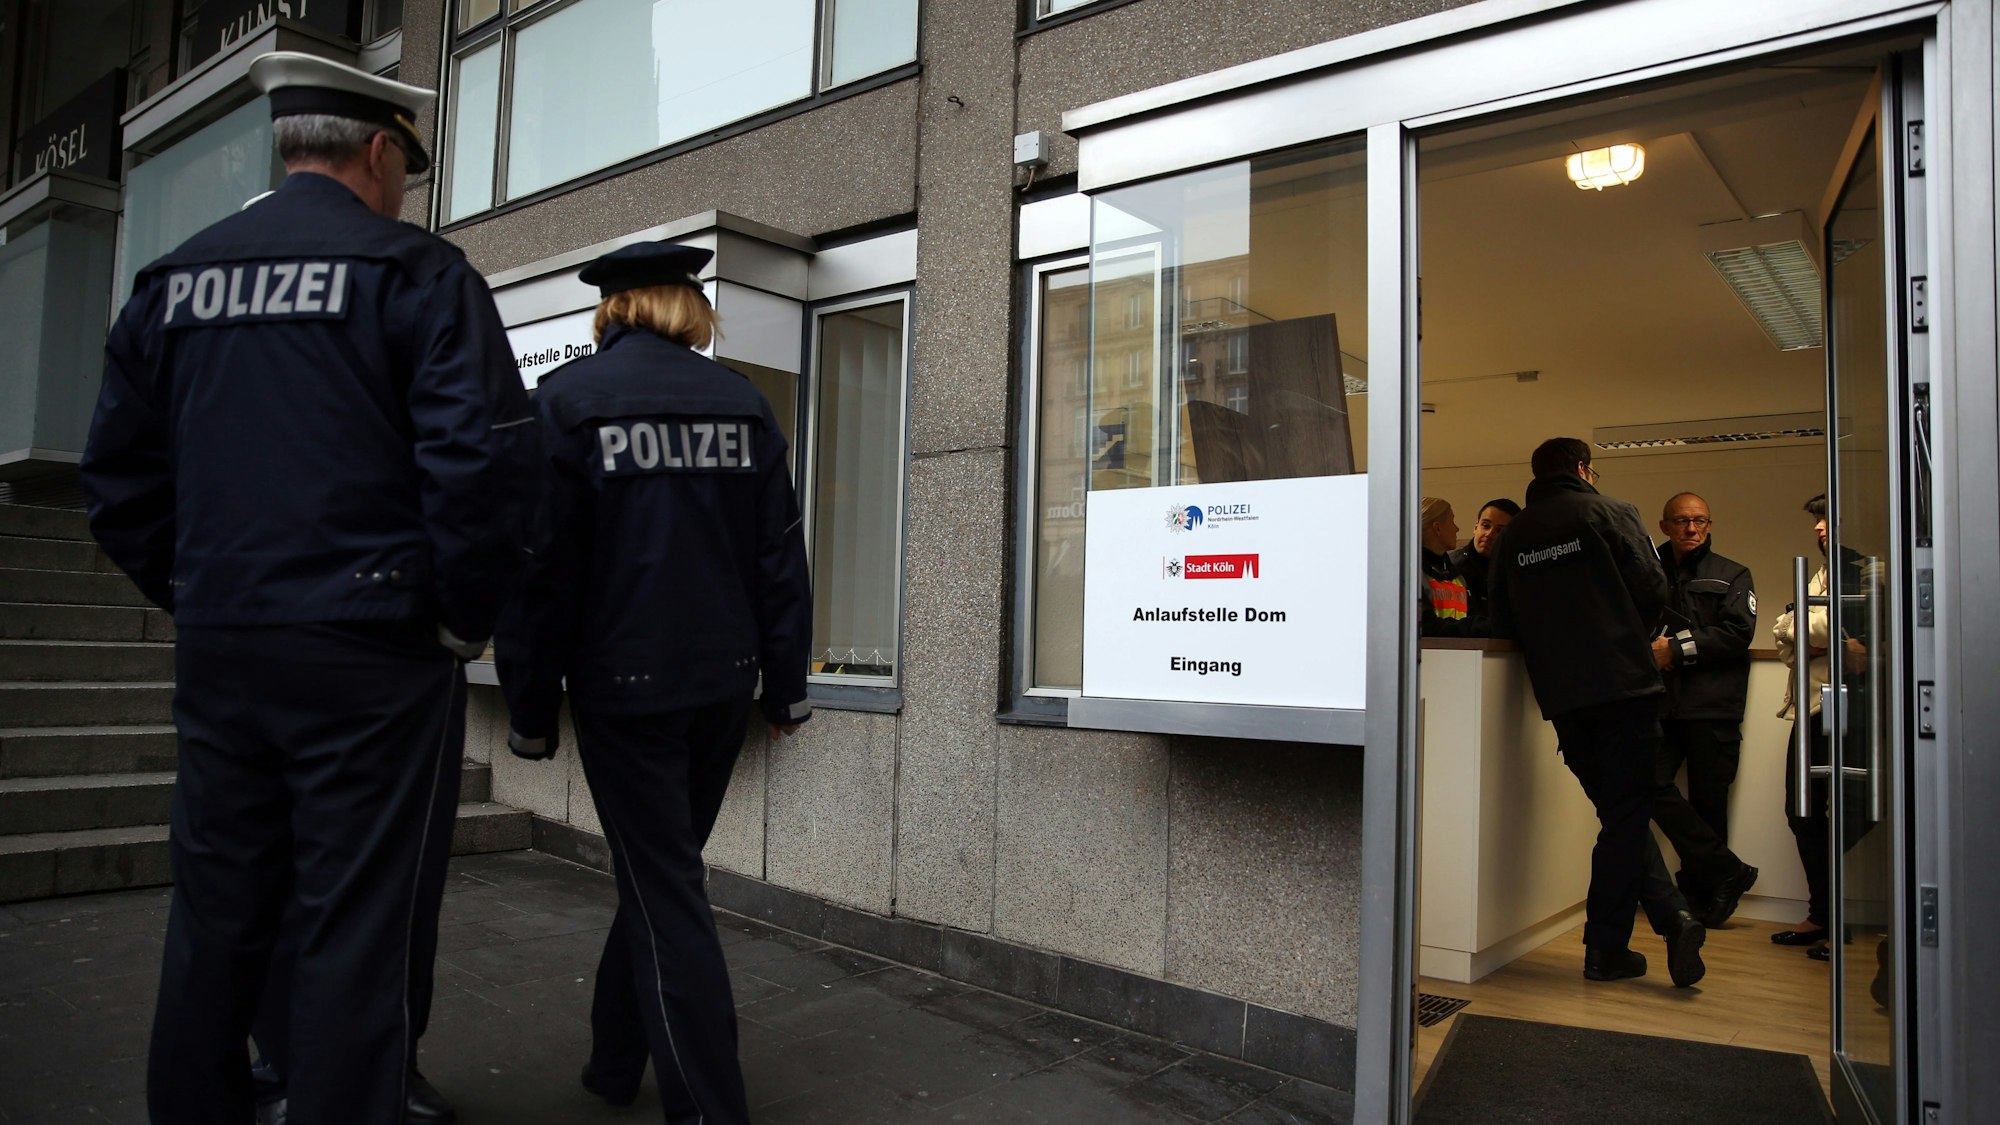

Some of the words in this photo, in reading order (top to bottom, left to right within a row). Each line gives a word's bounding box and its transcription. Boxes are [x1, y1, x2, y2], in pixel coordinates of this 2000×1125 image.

[35, 123, 88, 173] KÖSEL
[164, 262, 348, 325] POLIZEI
[565, 343, 593, 360] Dom
[598, 421, 752, 472] POLIZEI
[1207, 504, 1251, 516] POLIZEI
[1207, 515, 1260, 523] Nordrhein-Westfalen
[1517, 537, 1582, 567] Ordnungsamt
[1186, 561, 1212, 573] Stadt
[1213, 561, 1235, 573] Köln
[1133, 607, 1239, 622] Anlaufstelle
[1245, 607, 1287, 622] Dom
[1170, 656, 1242, 676] Eingang
